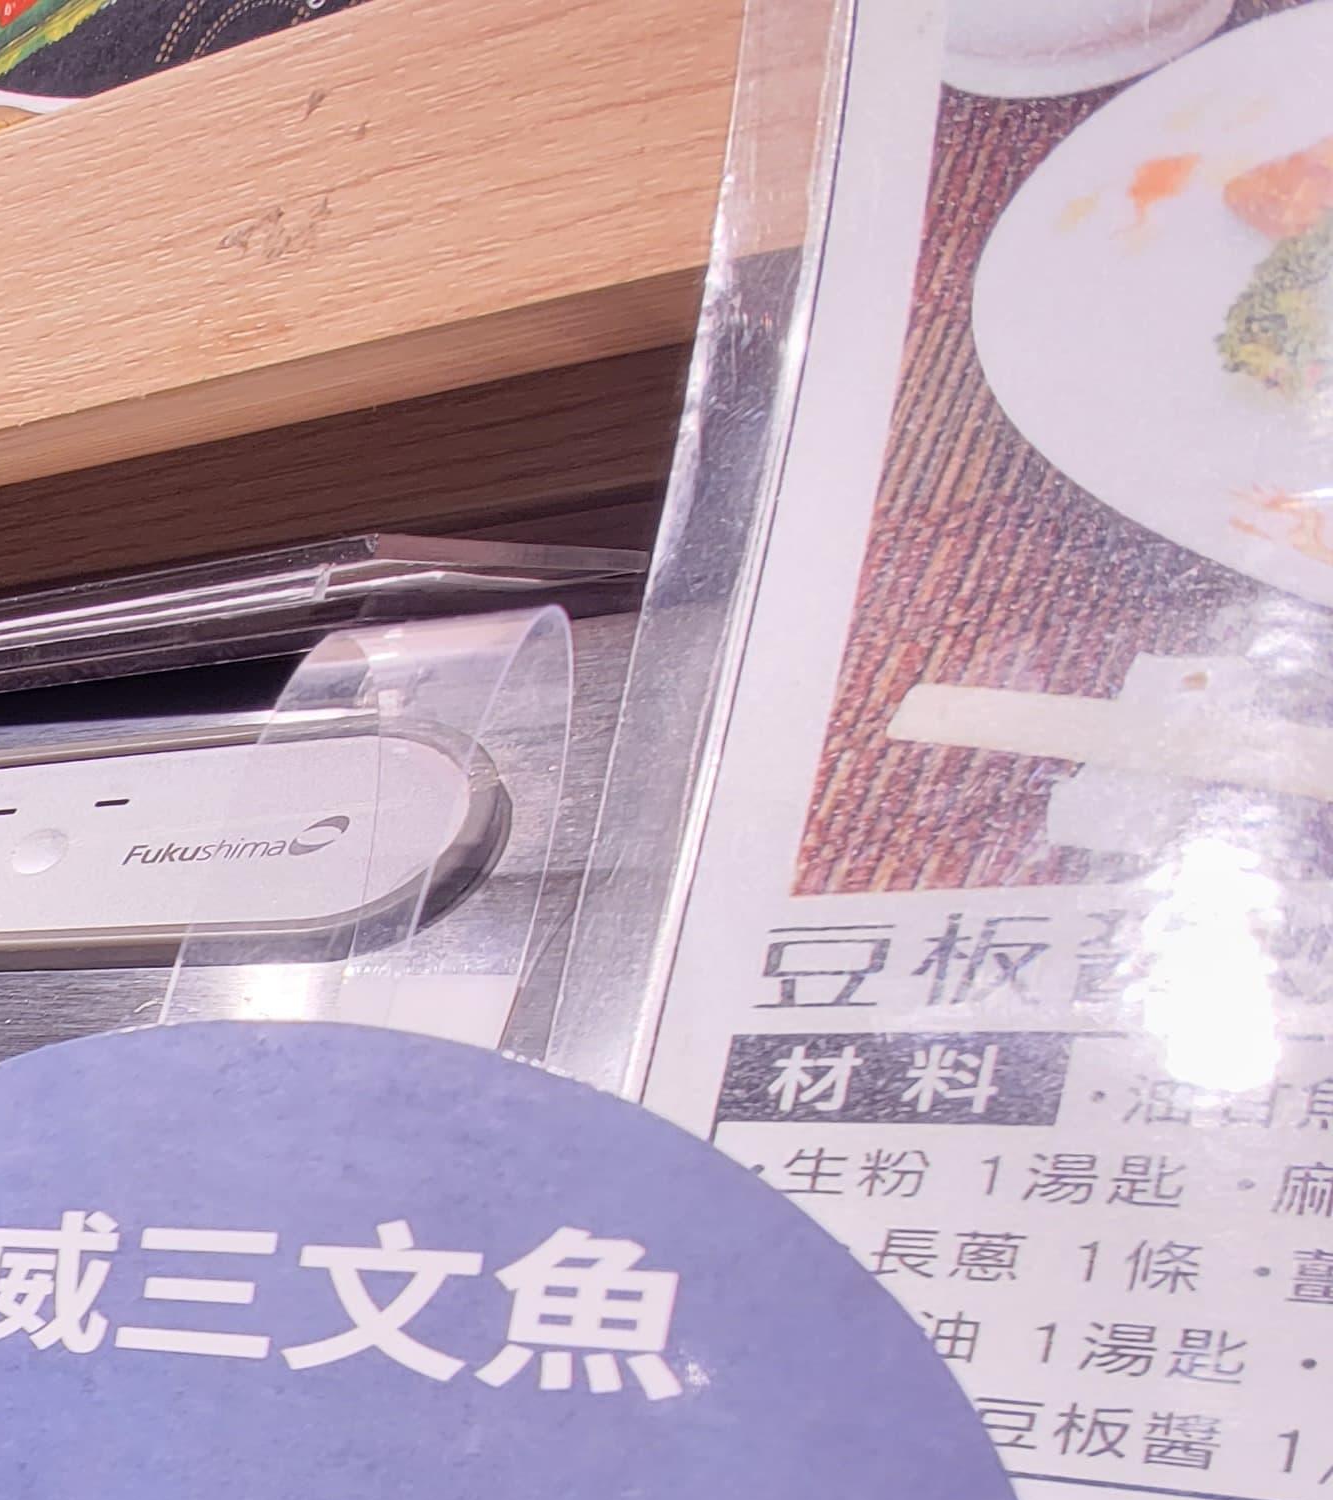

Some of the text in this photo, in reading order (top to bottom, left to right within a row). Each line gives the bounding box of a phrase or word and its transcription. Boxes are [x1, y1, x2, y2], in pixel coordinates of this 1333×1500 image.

[122, 837, 286, 866] Fukushima
[767, 1044, 1000, 1114] 材料
[782, 1147, 930, 1199] 生粉
[973, 1397, 1221, 1471] 豆板醬
